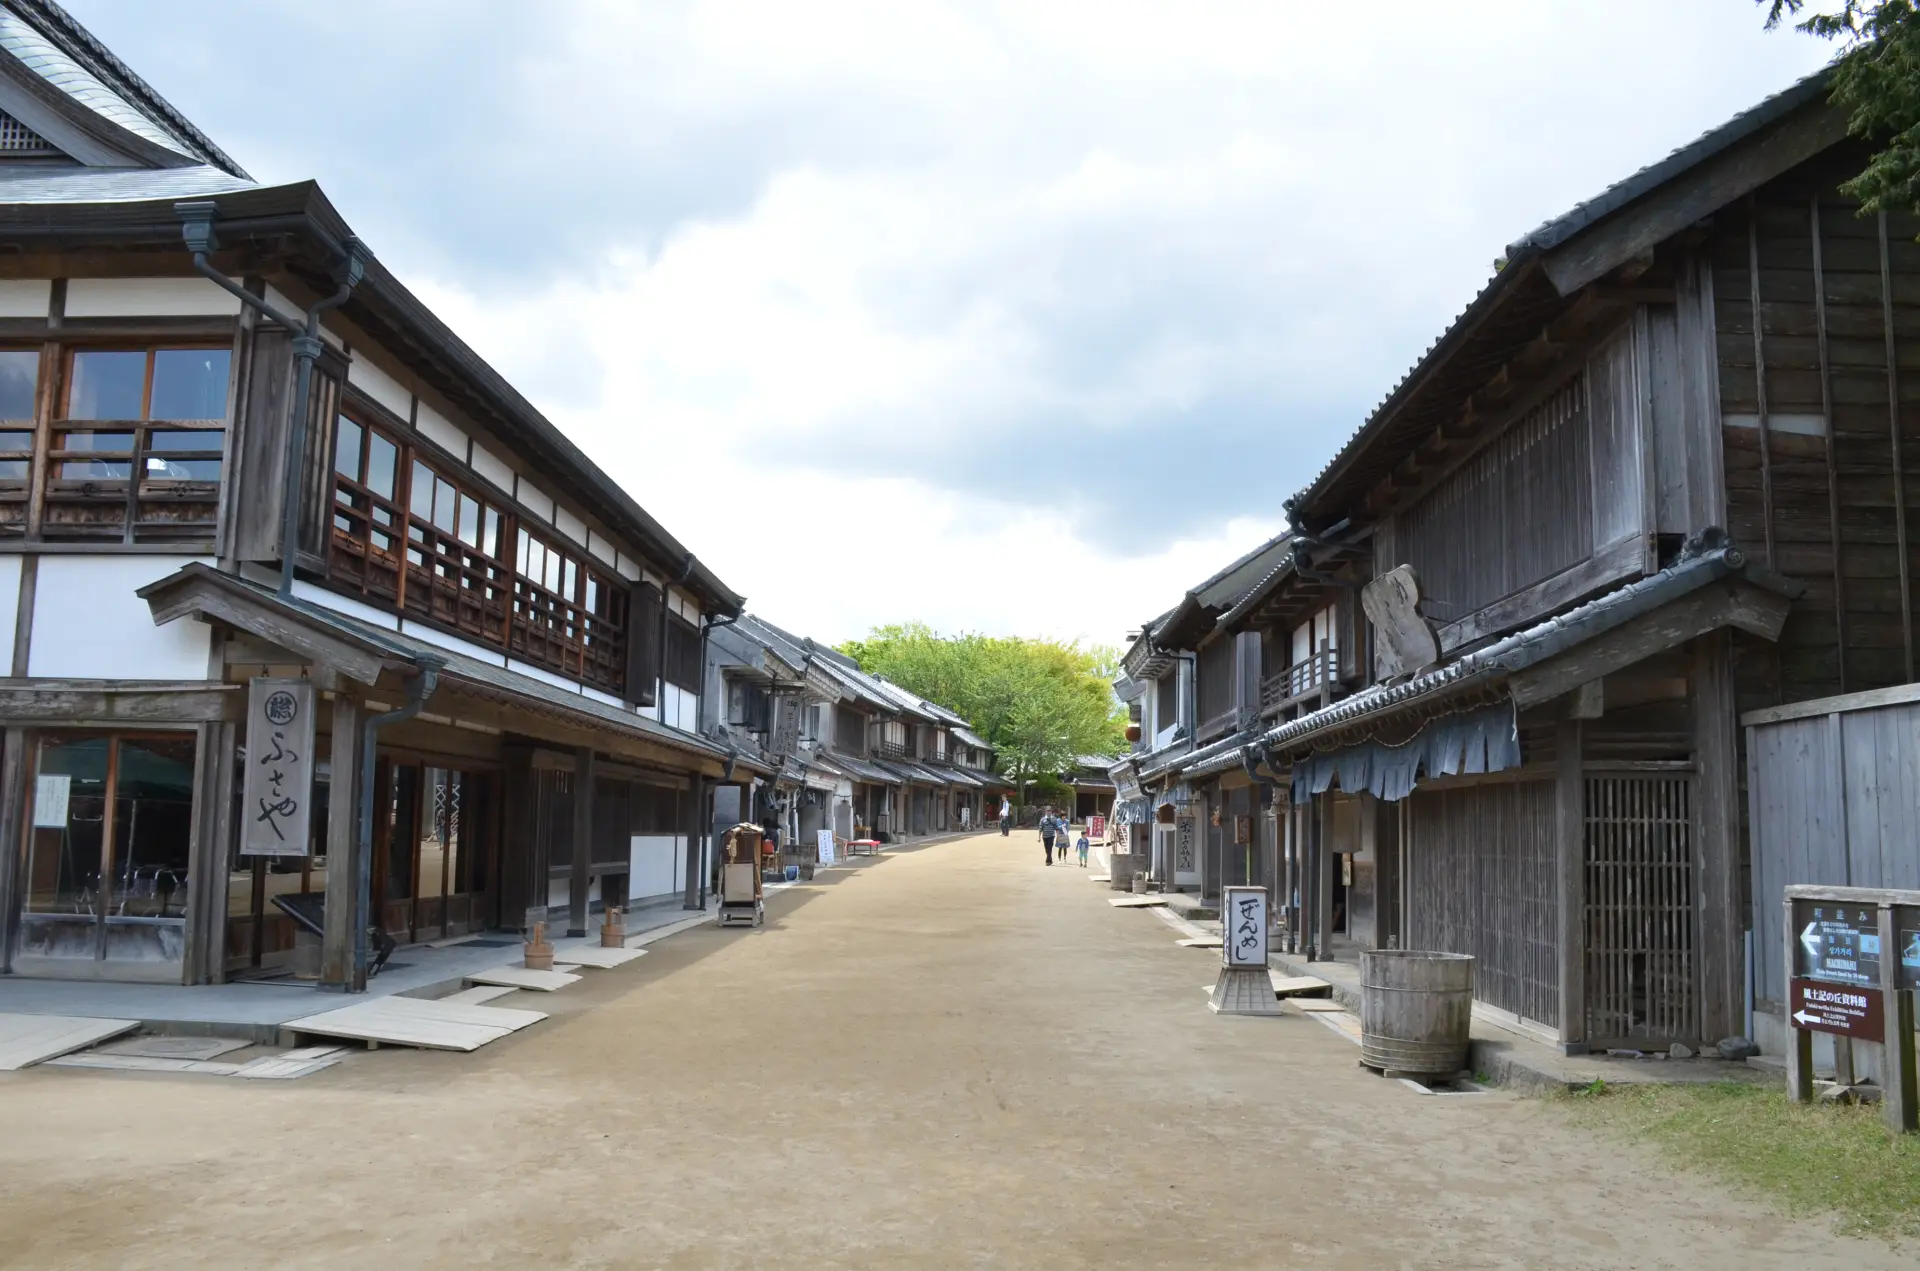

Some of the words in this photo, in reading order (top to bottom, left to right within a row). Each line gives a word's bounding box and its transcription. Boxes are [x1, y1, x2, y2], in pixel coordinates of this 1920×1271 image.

[257, 731, 299, 841] ふさや
[1803, 988, 1867, 1008] 風土記の丘資料館
